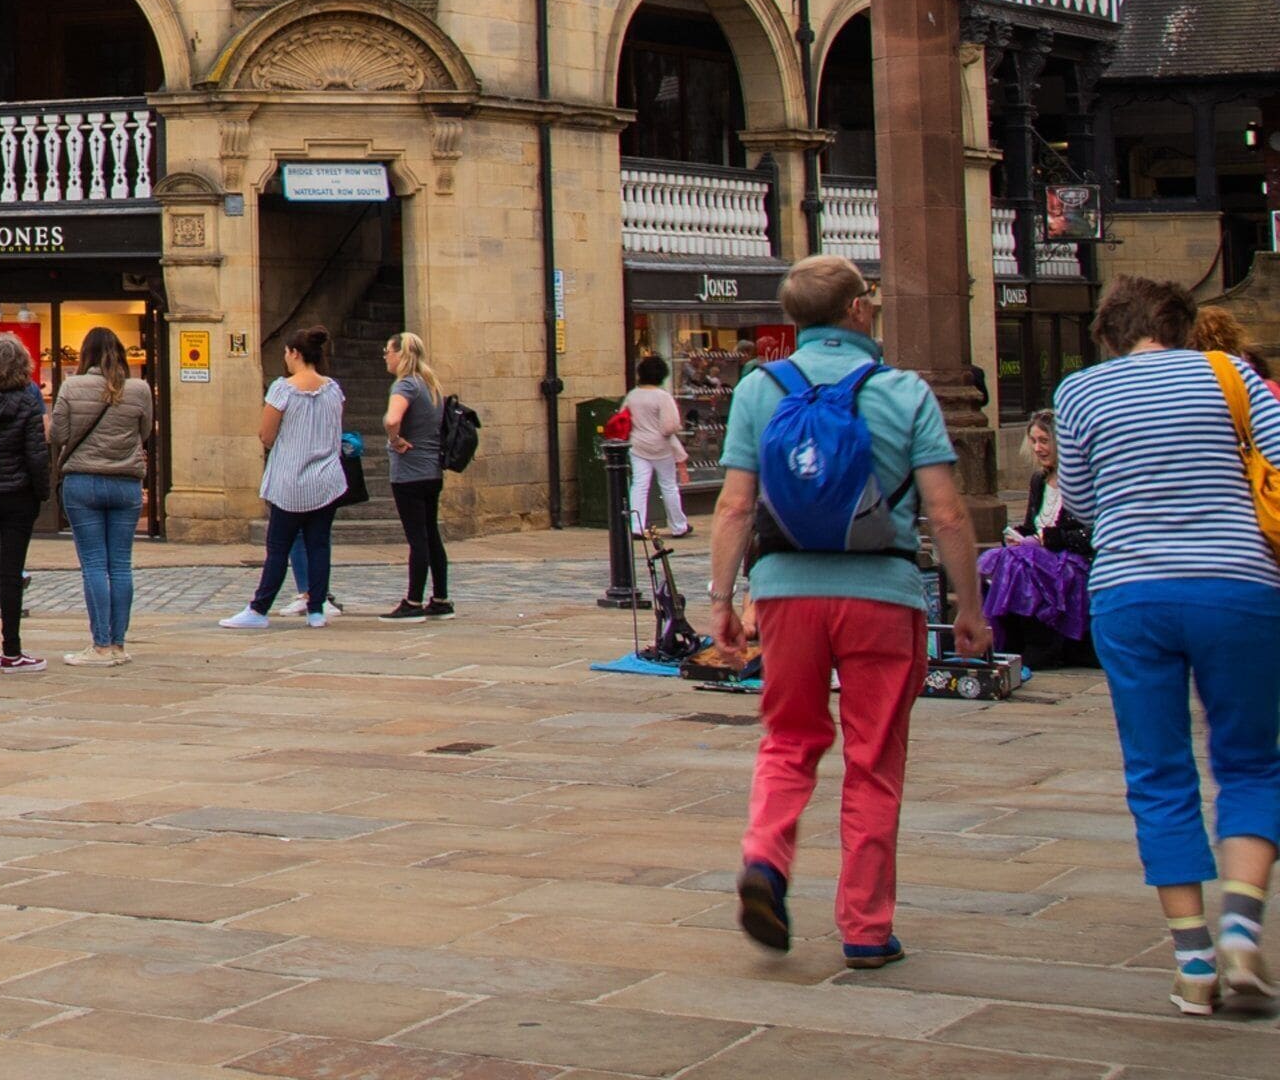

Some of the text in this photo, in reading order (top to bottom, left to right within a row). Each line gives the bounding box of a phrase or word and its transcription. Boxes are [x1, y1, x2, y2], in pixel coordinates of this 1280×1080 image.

[288, 168, 382, 176] BRIDGE STREET ROW WEST
[338, 188, 353, 196] ROW
[694, 274, 738, 301] JONES
[1000, 284, 1028, 307] JONES
